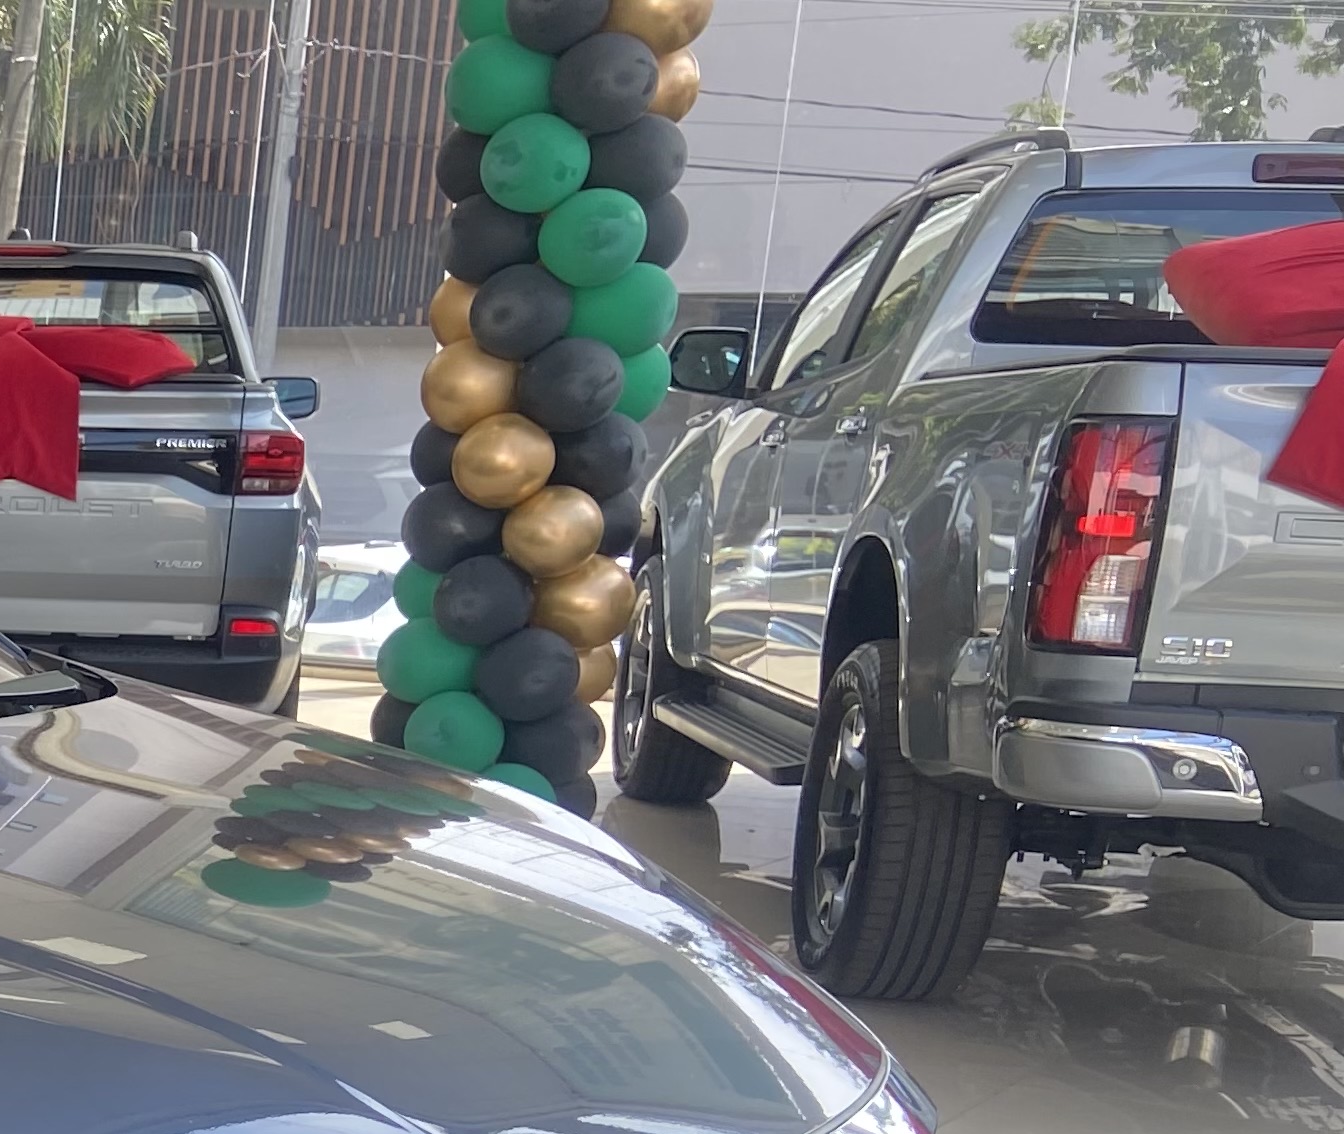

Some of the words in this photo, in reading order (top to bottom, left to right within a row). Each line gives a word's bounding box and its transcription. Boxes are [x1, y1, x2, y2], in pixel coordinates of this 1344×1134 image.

[155, 437, 228, 449] PREMIER
[1160, 635, 1234, 659] S10
[1155, 655, 1199, 665] JAVEP
